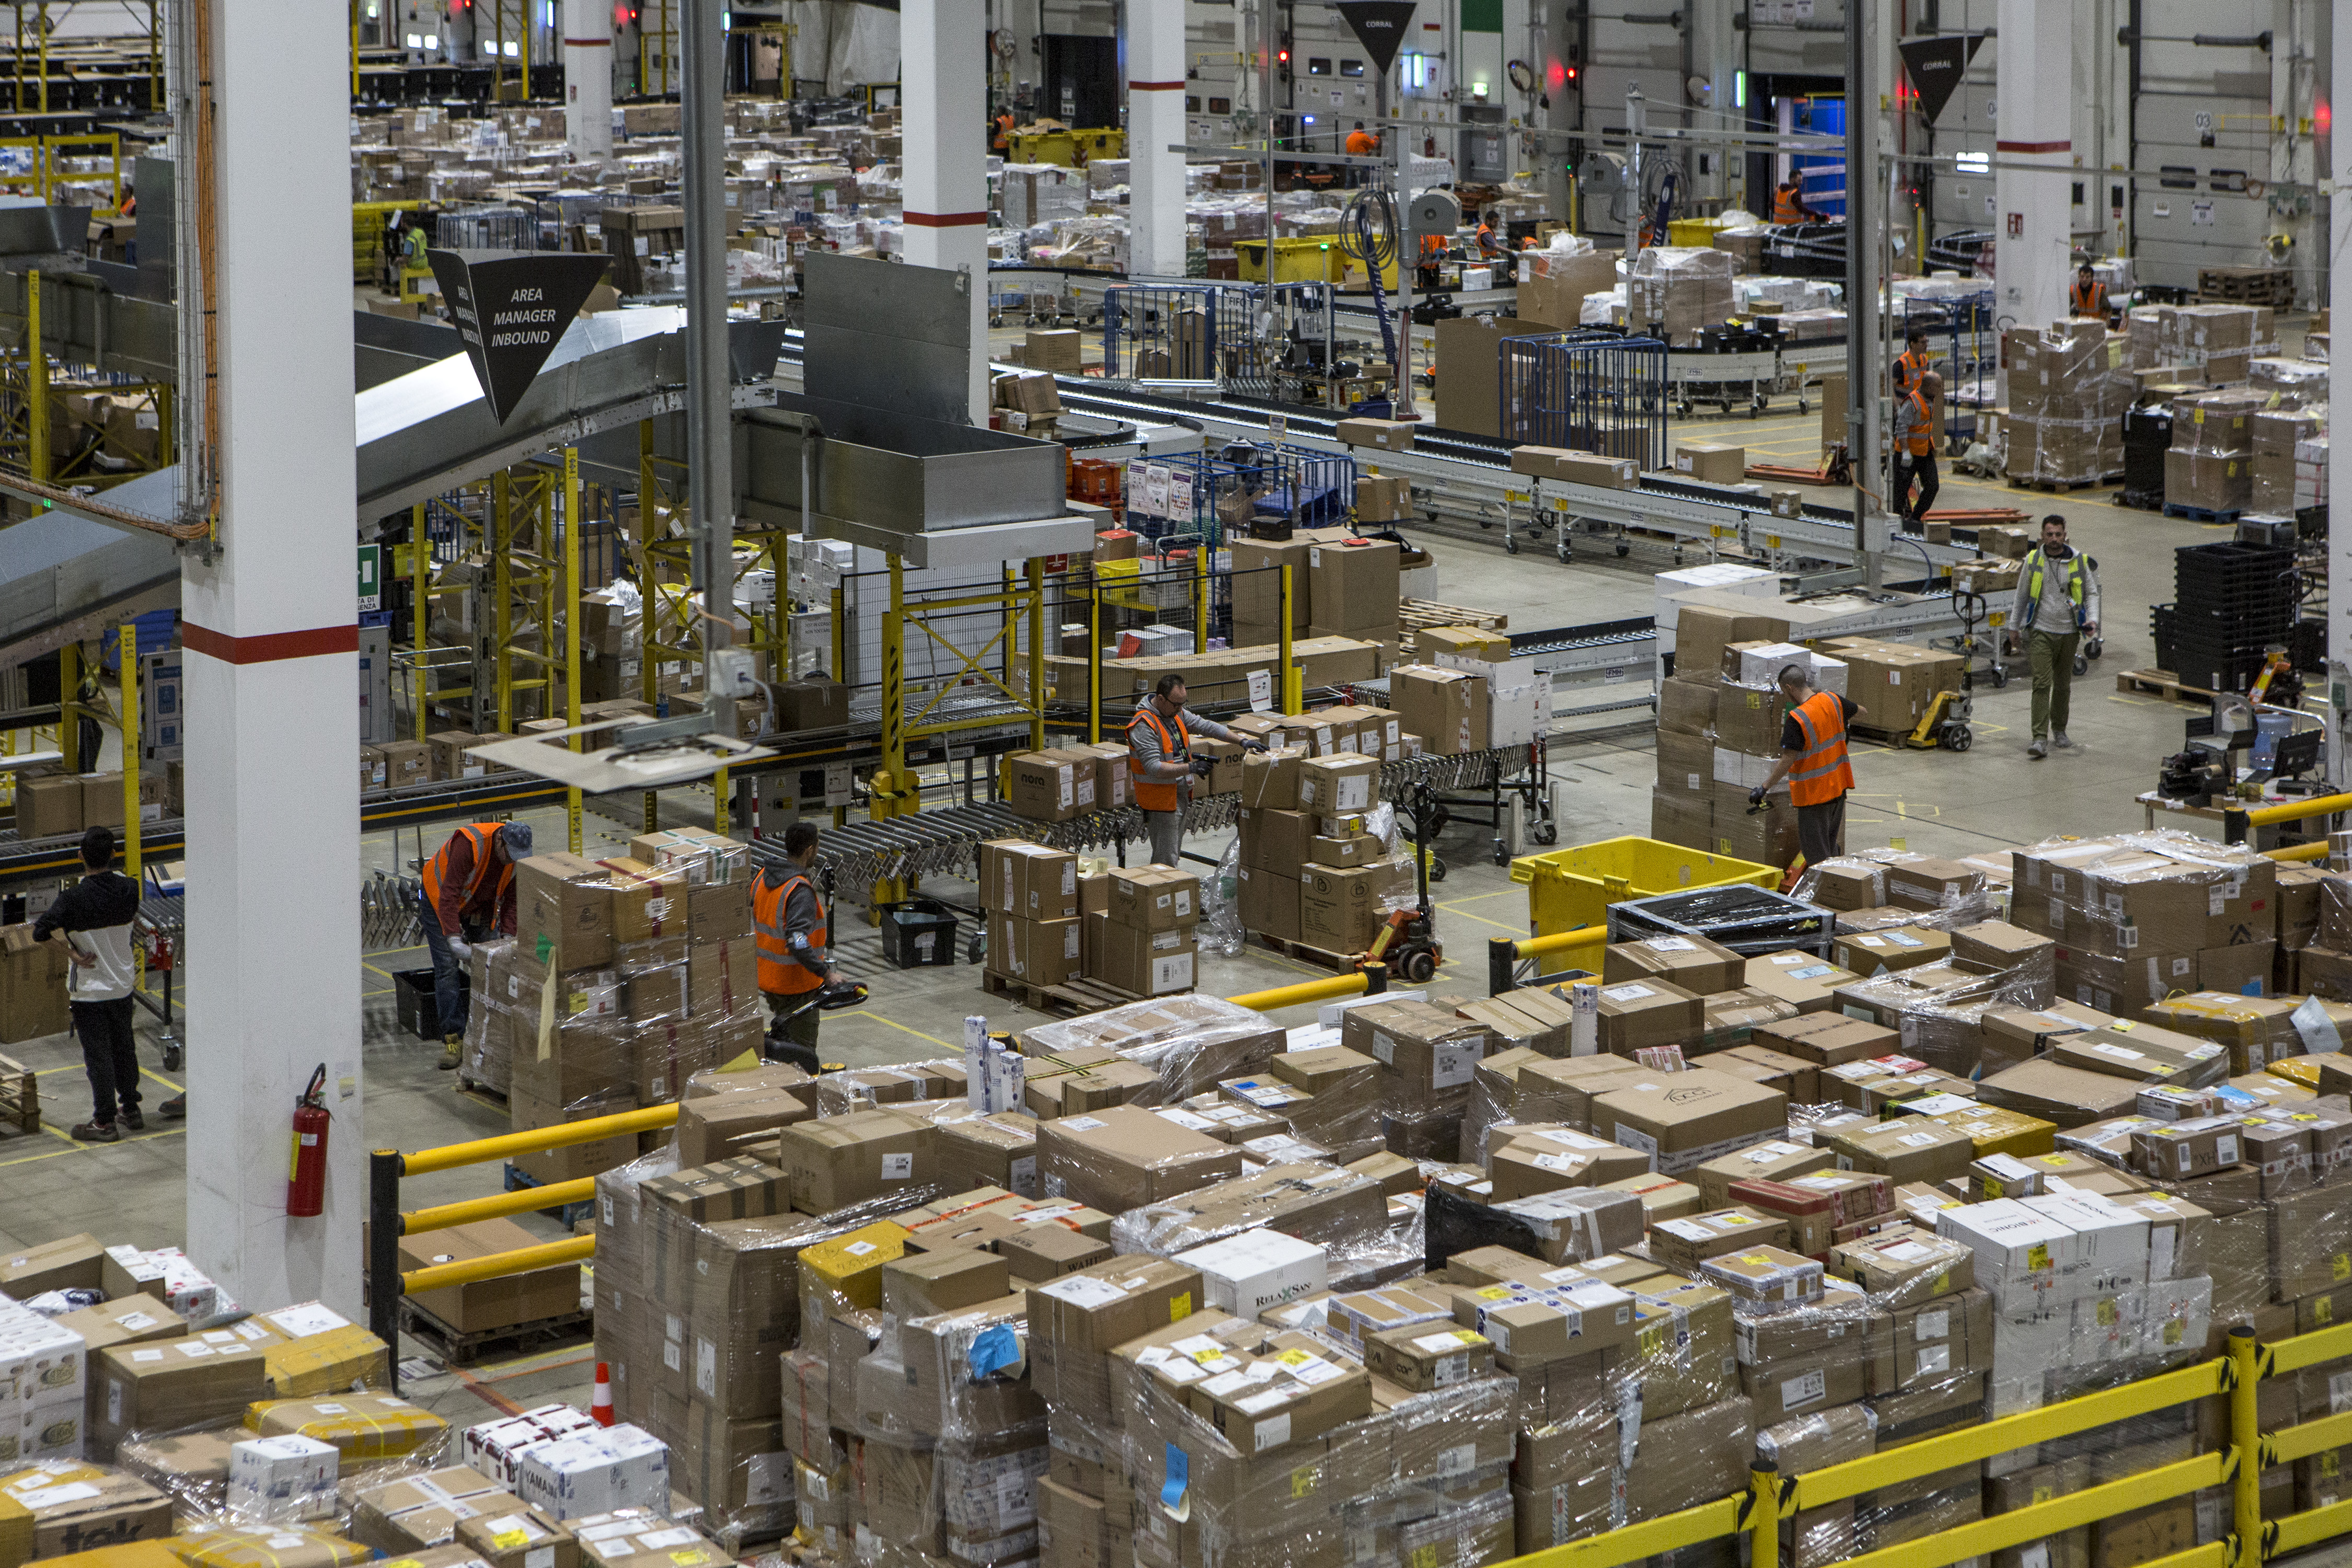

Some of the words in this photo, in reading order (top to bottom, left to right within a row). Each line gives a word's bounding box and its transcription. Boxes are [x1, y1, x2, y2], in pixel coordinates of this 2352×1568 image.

[1922, 61, 1951, 71] CORRAL
[2195, 112, 2211, 128] 03
[511, 288, 543, 303] AREA
[1229, 296, 1247, 308] FIFO
[493, 308, 556, 326] MANAGER
[491, 329, 550, 348] INBOUND
[1225, 753, 1246, 764] nor
[1021, 774, 1045, 786] nora
[1988, 1221, 2028, 1232] BIONIC
